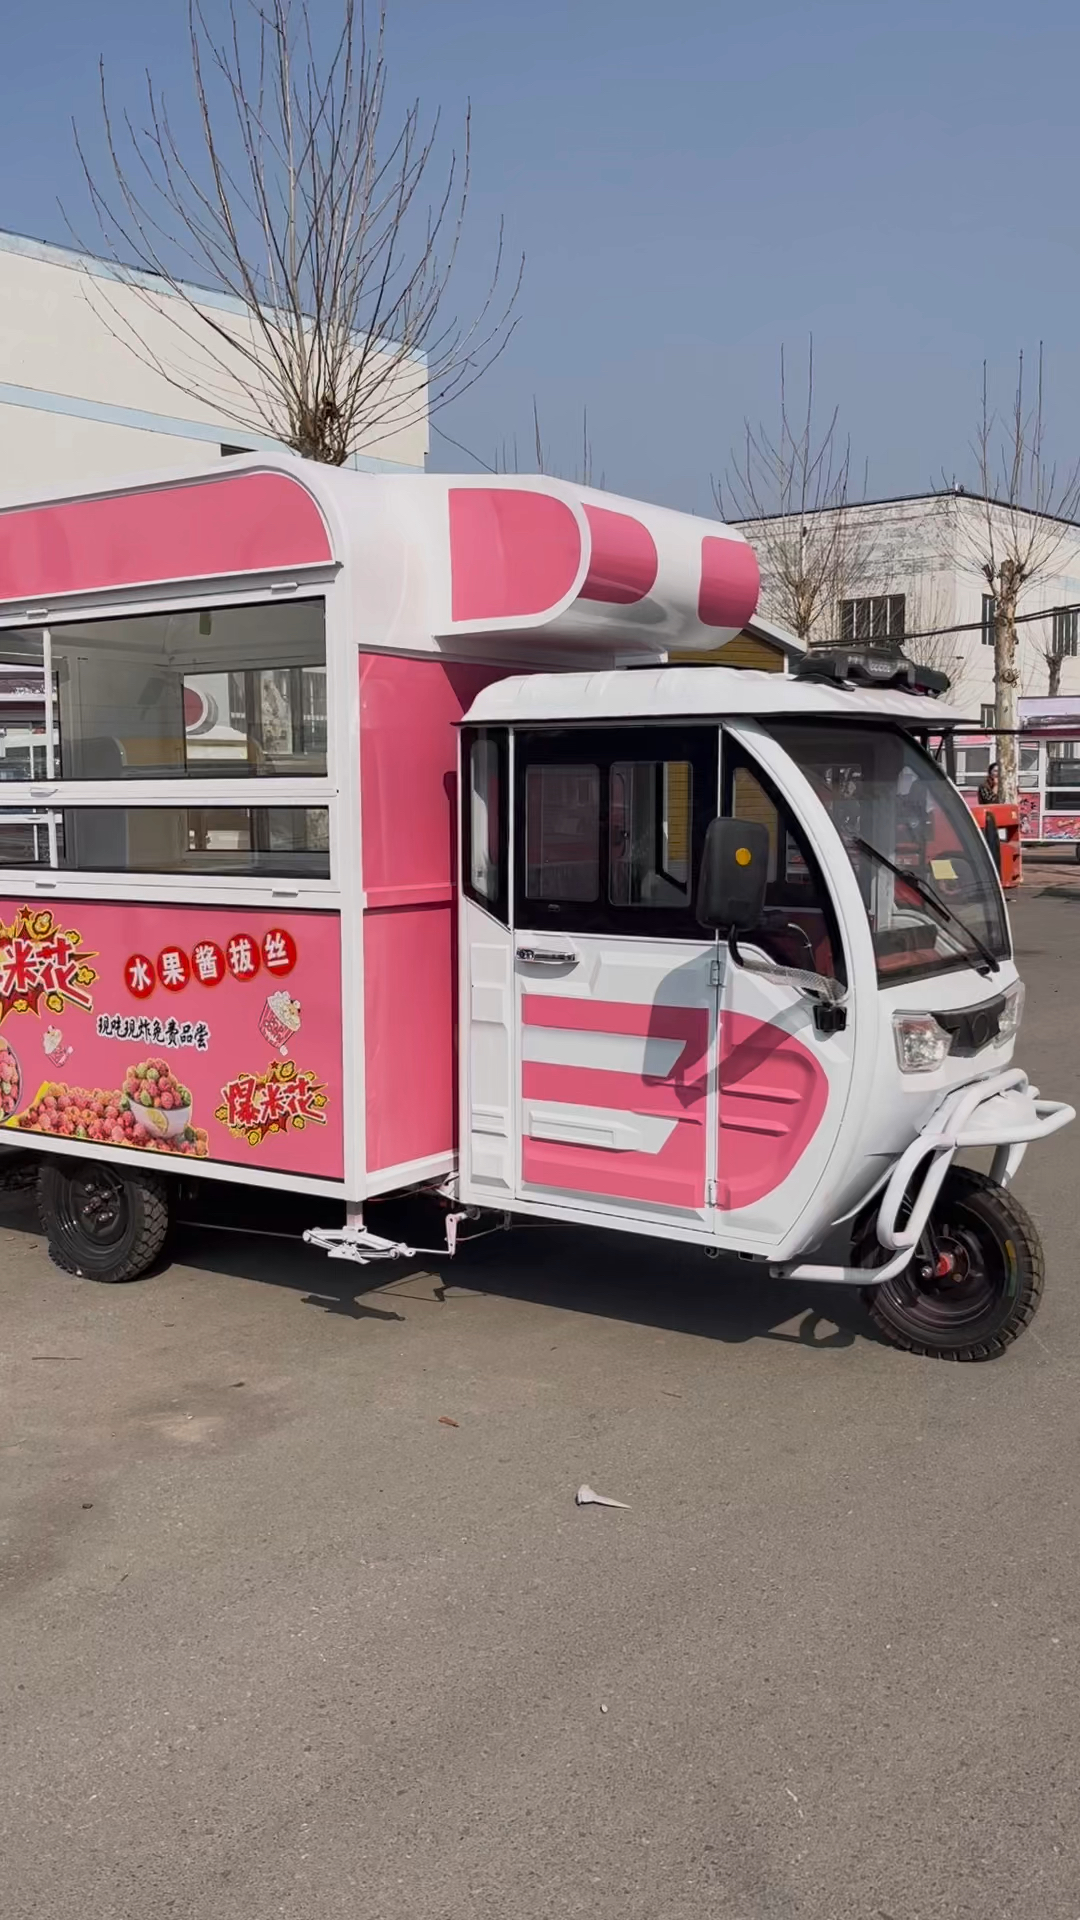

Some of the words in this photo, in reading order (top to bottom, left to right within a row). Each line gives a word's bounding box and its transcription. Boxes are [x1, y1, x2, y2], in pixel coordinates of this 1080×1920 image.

[0, 936, 92, 1006] 米花
[128, 932, 290, 991] 水果酱拔丝
[222, 1075, 326, 1126] 爆米花
